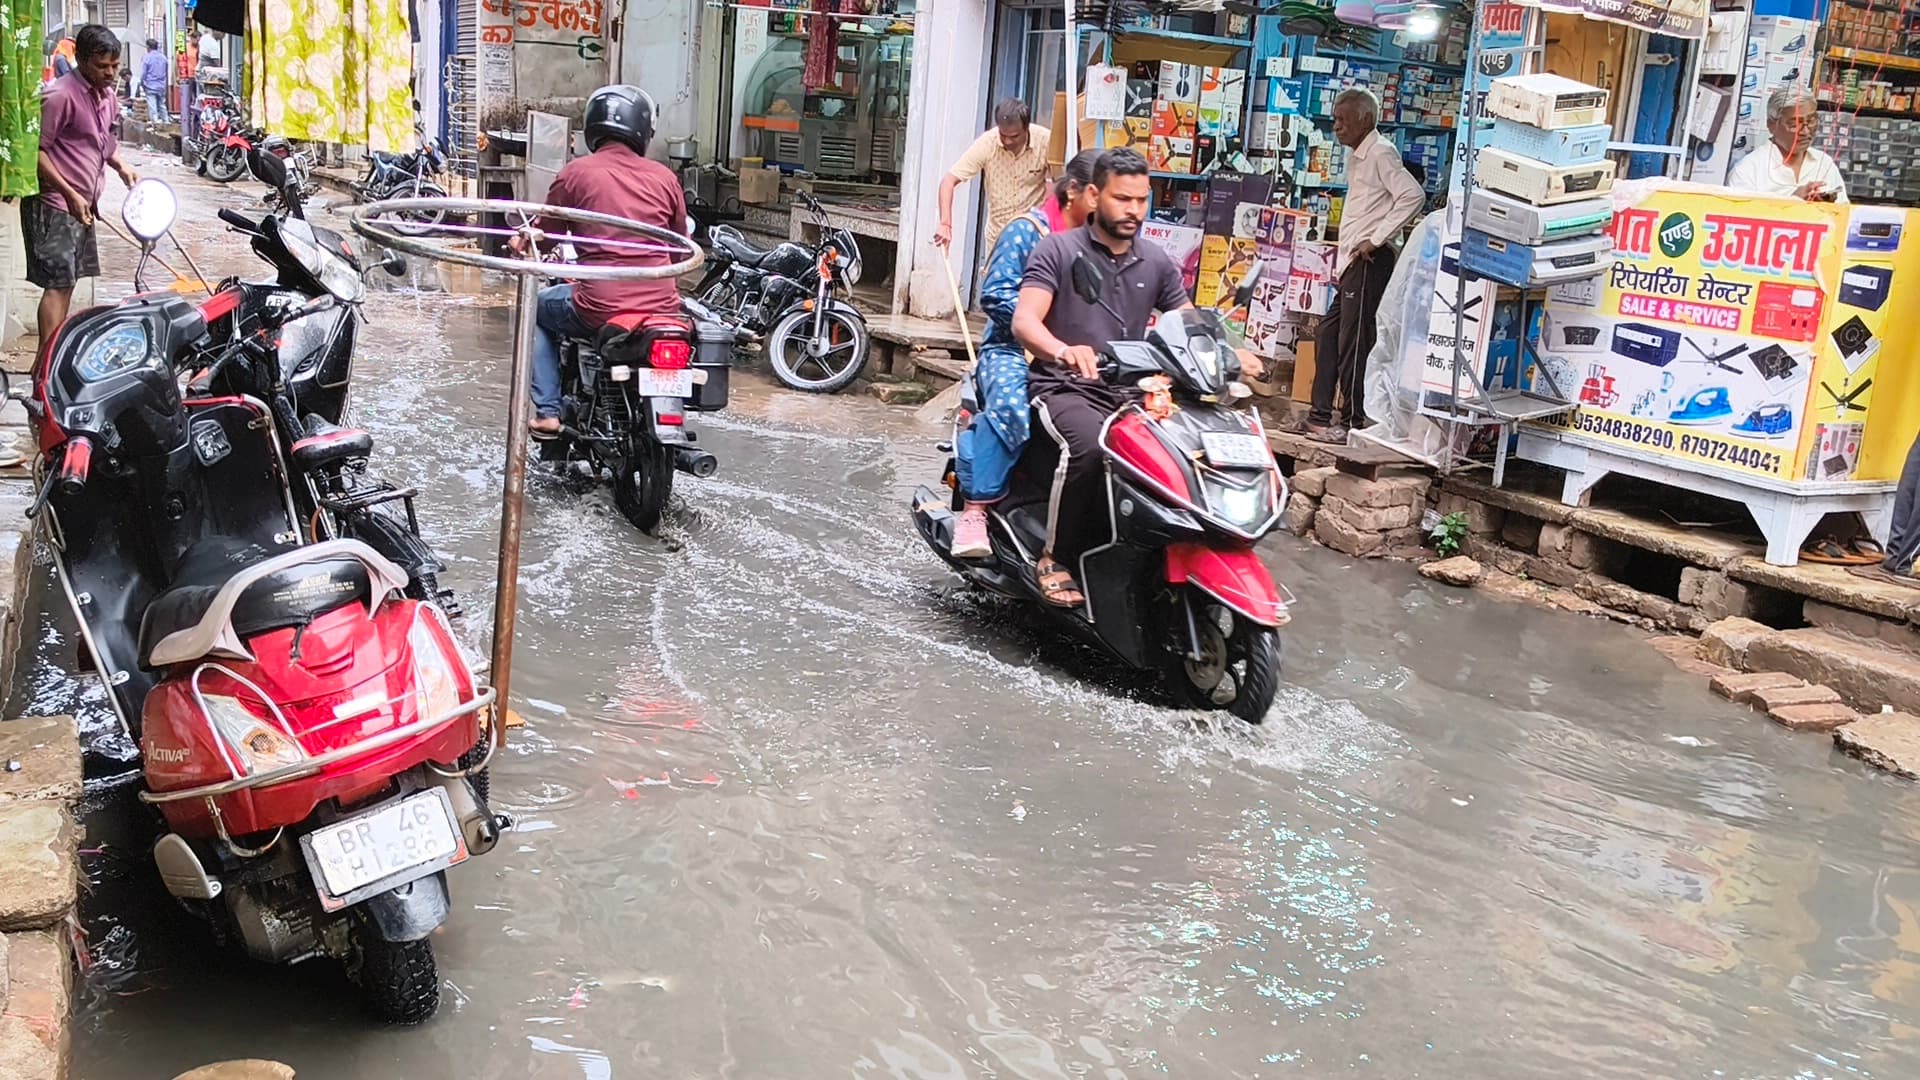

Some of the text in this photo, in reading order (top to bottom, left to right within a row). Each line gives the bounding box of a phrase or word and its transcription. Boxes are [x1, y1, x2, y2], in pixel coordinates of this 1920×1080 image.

[1661, 219, 1692, 252] एण्ड
[1702, 214, 1828, 273] उजाला
[1697, 273, 1753, 305] सेन्टर
[1621, 296, 1738, 329] SALE & SERVICE
[1680, 435, 1781, 474] 8797244041
[148, 741, 184, 762] ACTIVA
[337, 803, 430, 854] BR 46
